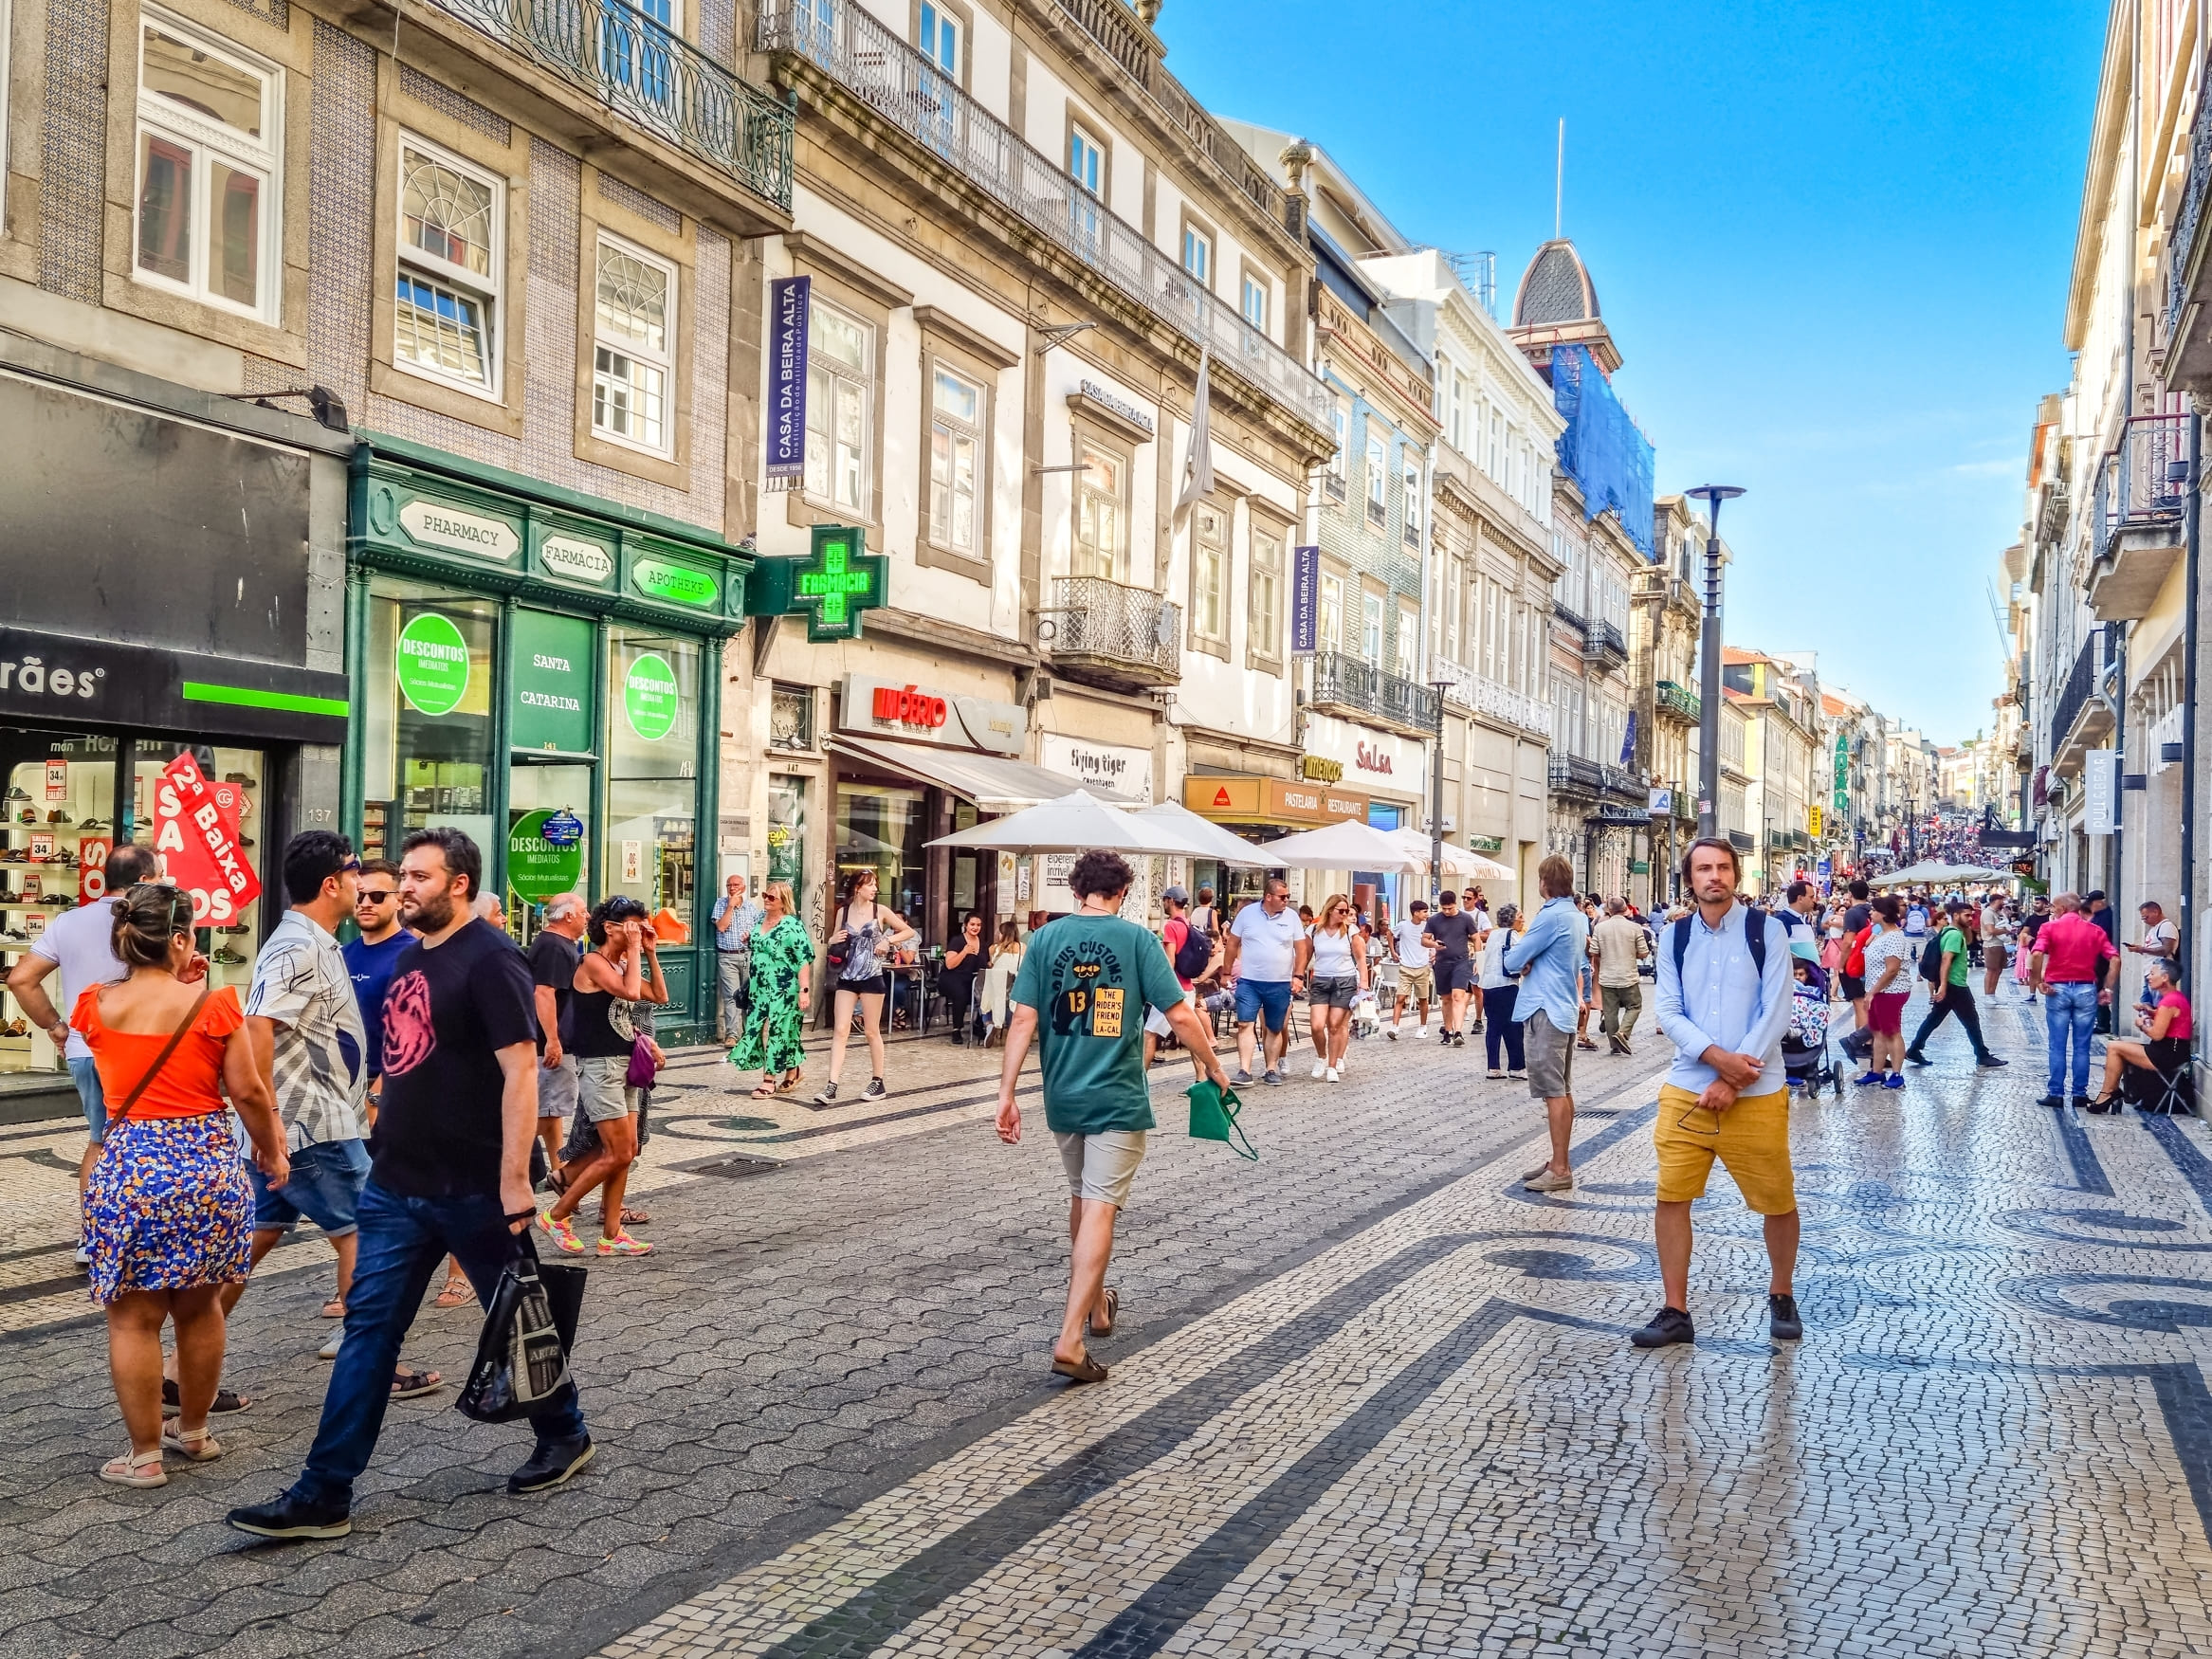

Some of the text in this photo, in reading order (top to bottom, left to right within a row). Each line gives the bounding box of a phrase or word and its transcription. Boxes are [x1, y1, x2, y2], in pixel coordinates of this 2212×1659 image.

[778, 283, 795, 459] CASA DA BEIRA ALTA
[424, 515, 499, 547] PHARMACY
[545, 544, 610, 573] FARMÁCIA
[1302, 550, 1310, 574] ALTA
[649, 570, 704, 595] APOTHEKE
[802, 572, 868, 594] FARMACIA
[1300, 605, 1308, 619] DA
[1299, 621, 1307, 647] CASA
[403, 638, 465, 663] DESCONTOS
[418, 659, 449, 672] IMEDIATOS
[533, 654, 571, 671] SANTA
[629, 675, 675, 695] DESCONTOS
[521, 691, 580, 711] CATARINA
[872, 684, 946, 727] IMPÉRIO
[1071, 748, 1126, 775] flying tiger
[1356, 740, 1393, 775] Salsa
[1285, 792, 1362, 815] PASTELARIA RESTAURANTE
[309, 809, 332, 823] 137
[193, 802, 247, 894] Baixa
[527, 854, 560, 864] IMEDIATOS
[518, 873, 536, 882] Sócios
[1052, 940, 1123, 983] DEUS CUSTOMS
[1069, 991, 1086, 1012] 13
[1096, 1000, 1122, 1011] RIDER'S
[1104, 991, 1116, 999] THE
[1096, 1012, 1120, 1021] FRIEND
[1096, 1026, 1120, 1034] LA-CAL
